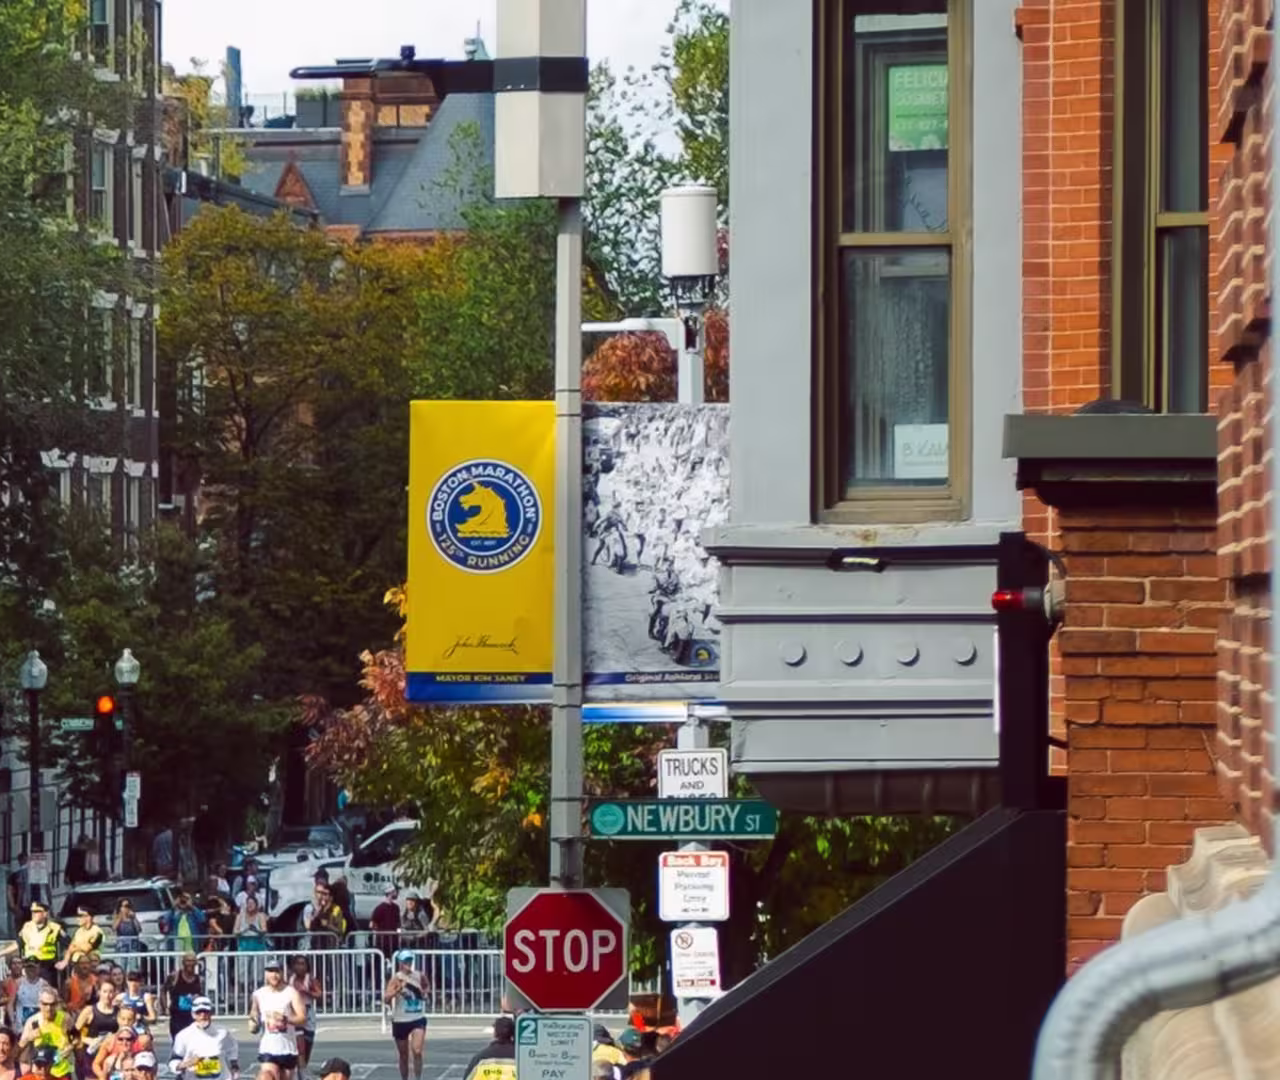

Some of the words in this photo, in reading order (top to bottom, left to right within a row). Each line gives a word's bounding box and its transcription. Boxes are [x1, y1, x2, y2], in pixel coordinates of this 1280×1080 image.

[432, 470, 469, 521] BOSTON
[467, 535, 529, 567] RUNNING
[624, 673, 662, 683] Original
[665, 758, 718, 776] TRUCKS
[680, 781, 704, 790] AND
[627, 805, 742, 833] NEWBURY
[745, 814, 762, 832] ST
[512, 929, 616, 973] STOP
[521, 1020, 536, 1037] 2
[542, 1069, 567, 1078] PAY
